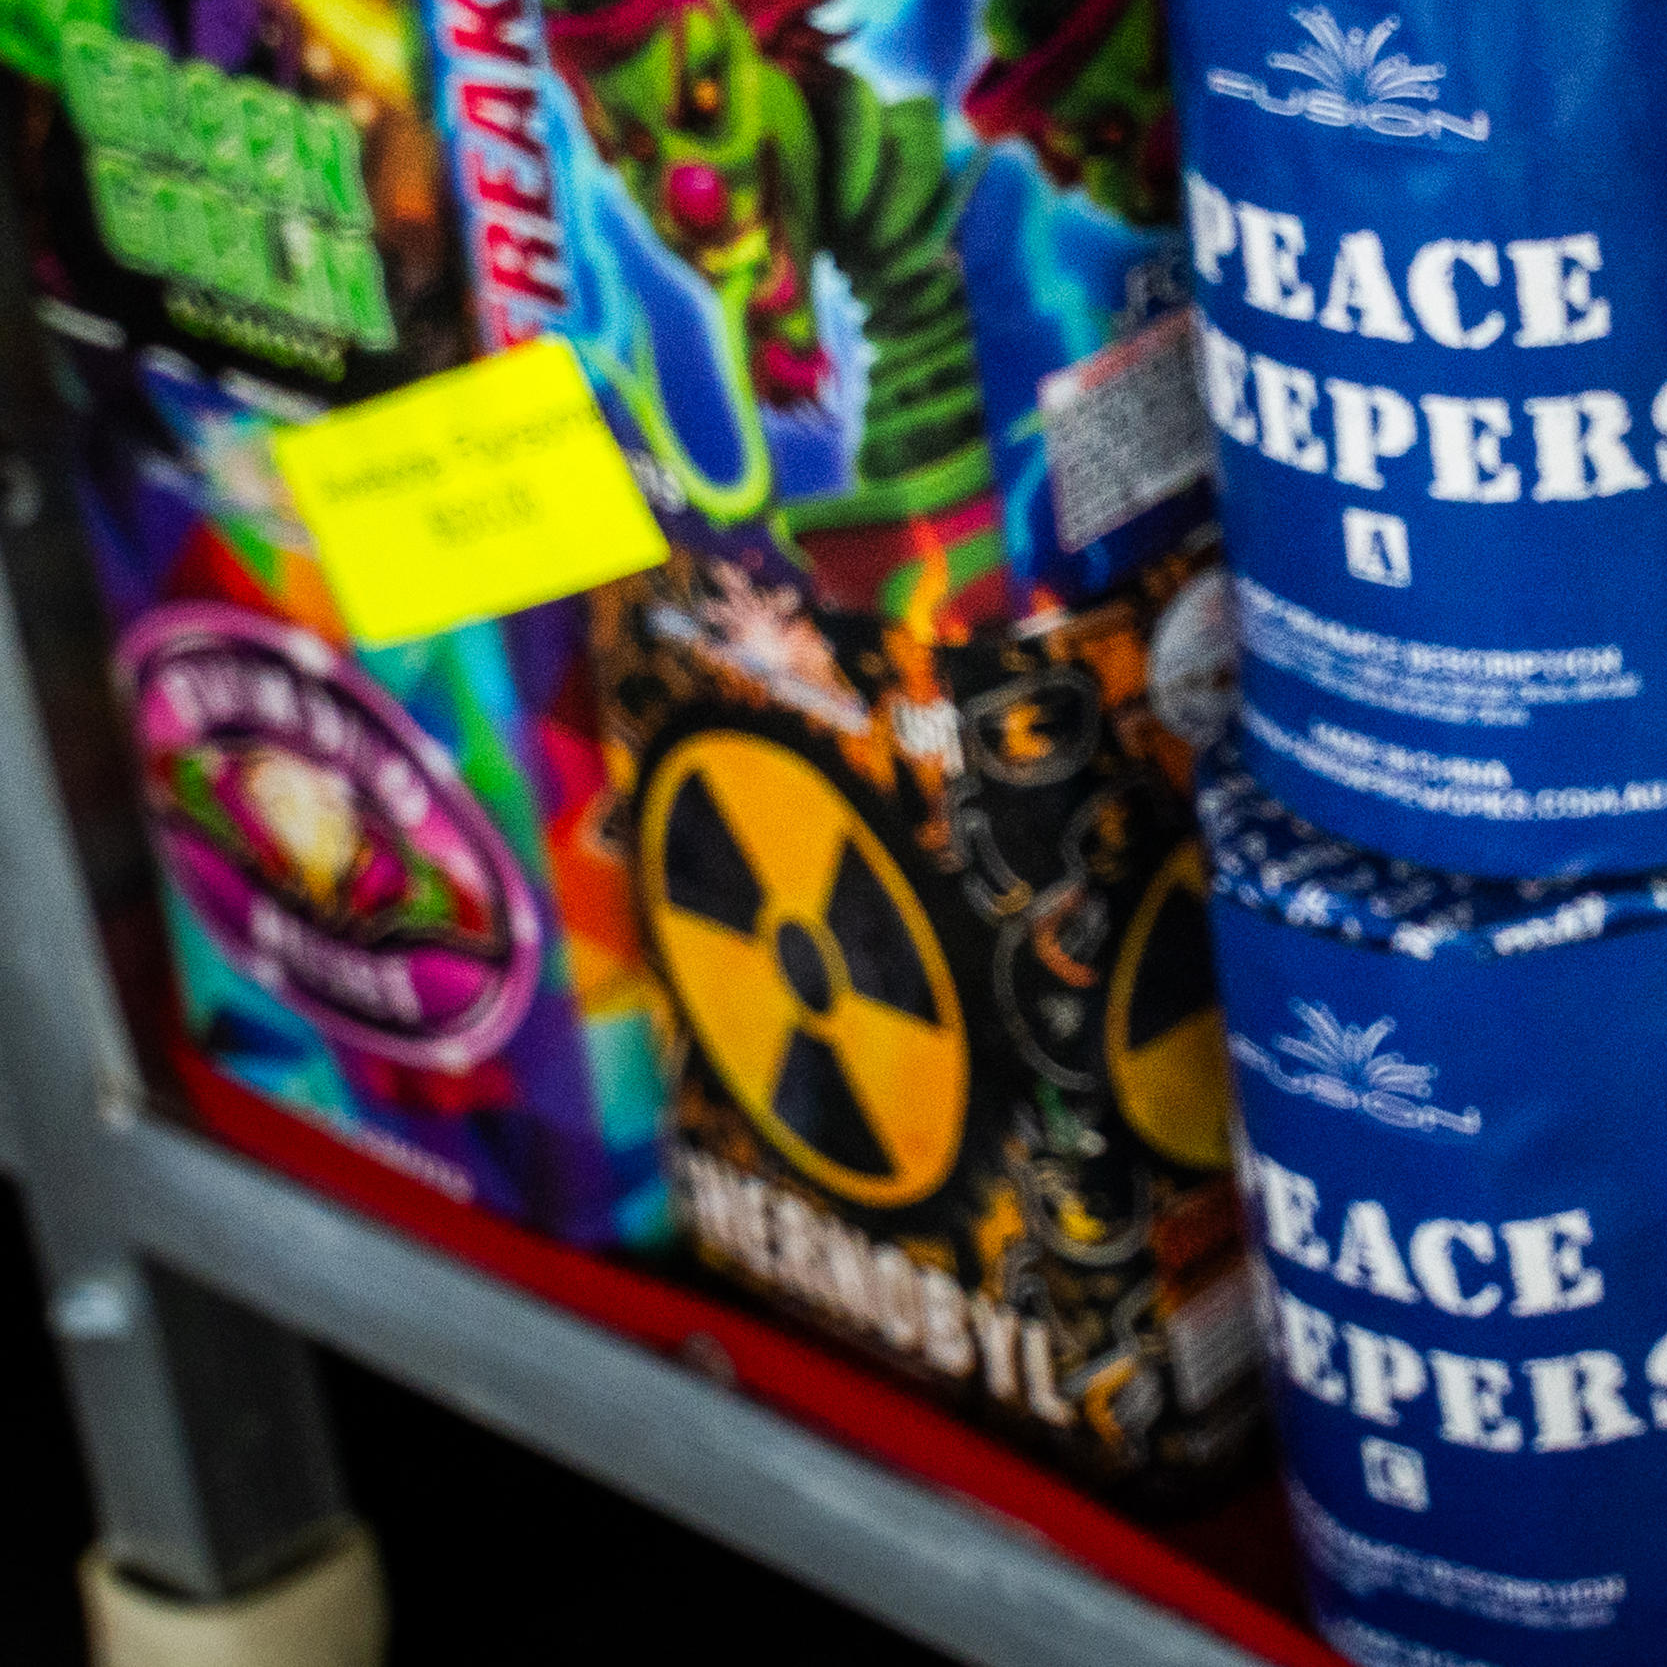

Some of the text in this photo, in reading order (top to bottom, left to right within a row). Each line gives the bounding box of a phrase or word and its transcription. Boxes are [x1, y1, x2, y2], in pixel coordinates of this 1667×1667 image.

[1205, 67, 1492, 142] FUSION
[1186, 170, 1612, 351] PEACE
[1242, 1147, 1607, 1320] EACE
